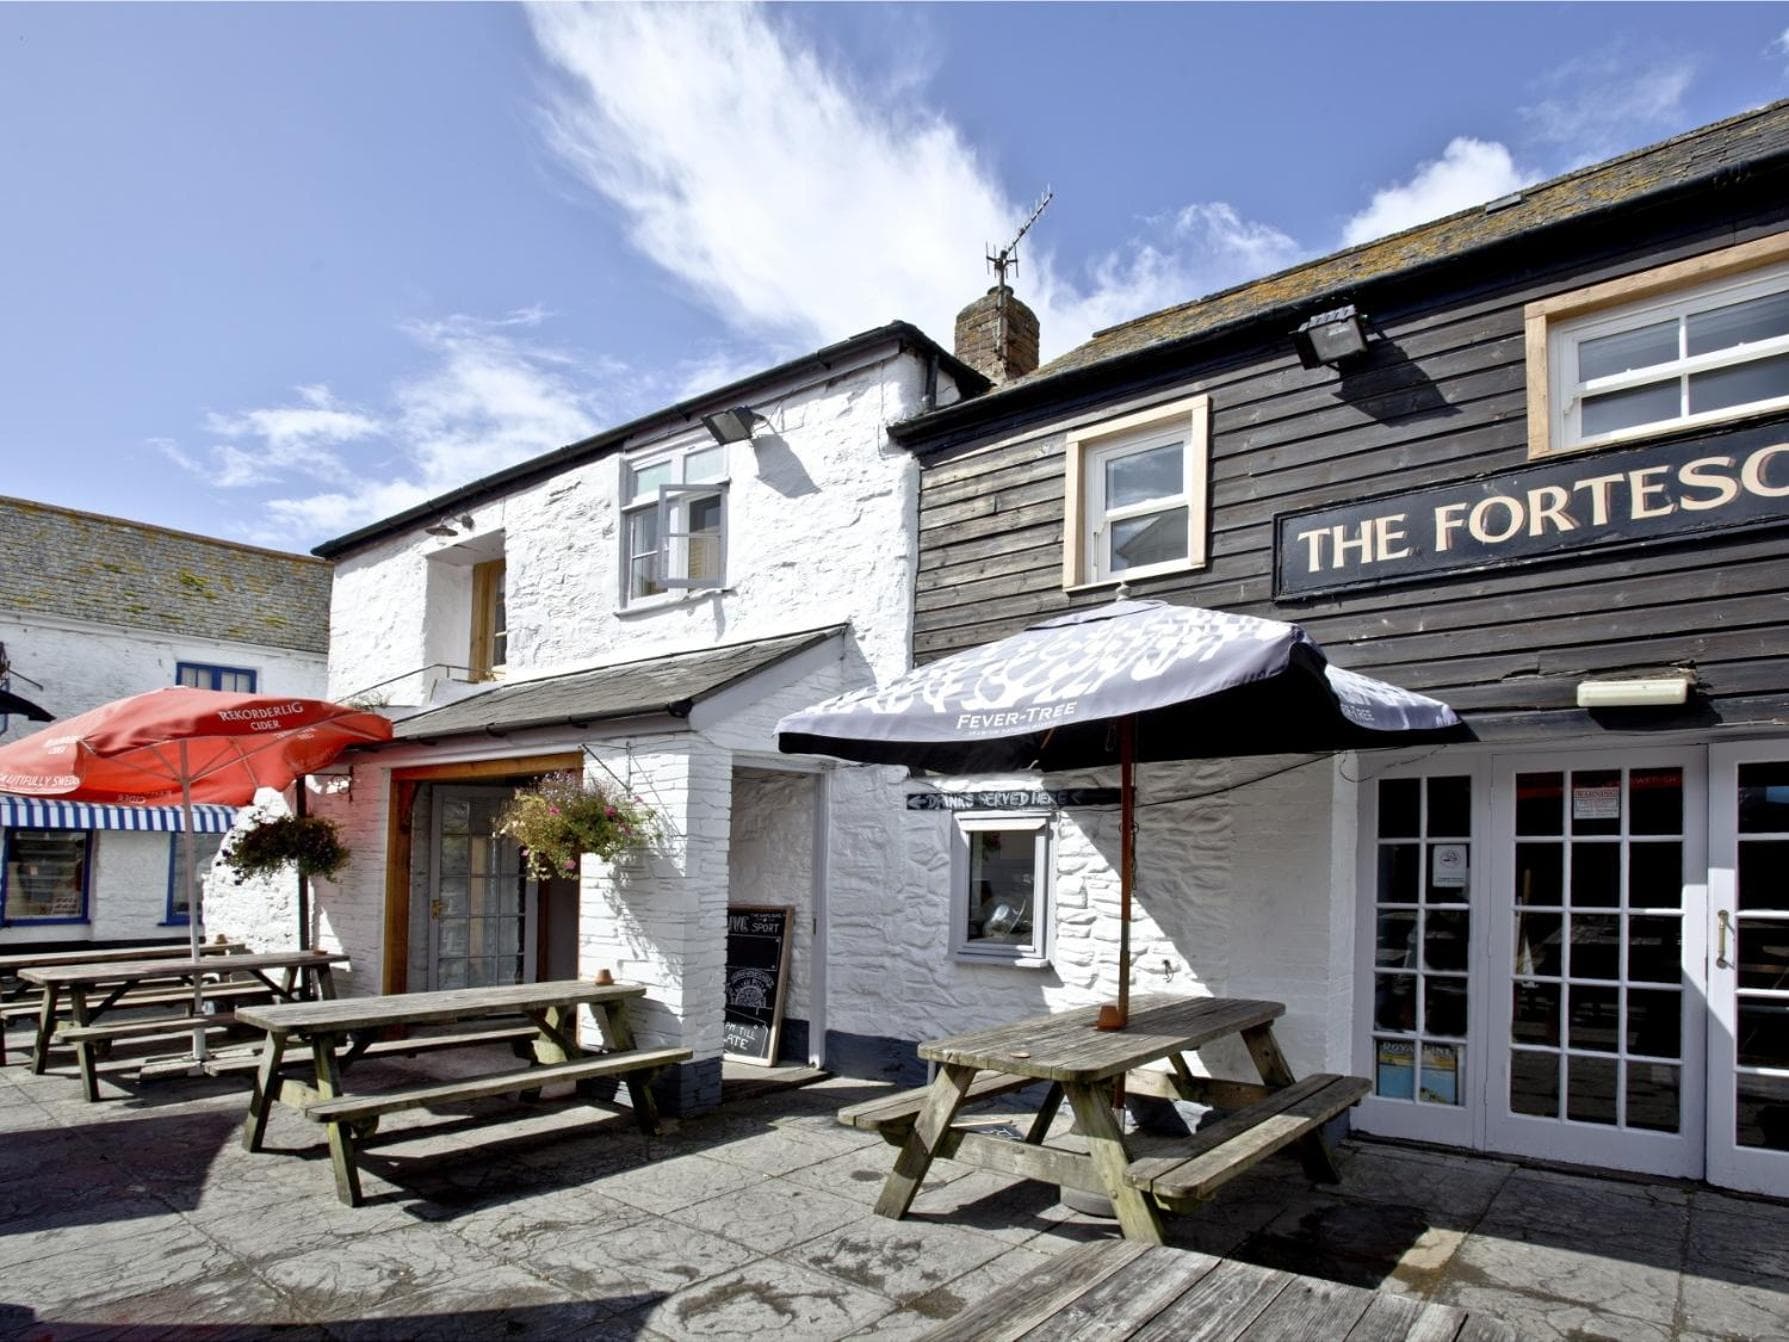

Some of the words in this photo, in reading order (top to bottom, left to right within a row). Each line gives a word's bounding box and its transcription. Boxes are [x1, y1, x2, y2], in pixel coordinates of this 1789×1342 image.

[1297, 513, 1411, 574] THE
[1434, 442, 1789, 552] FORTESC
[218, 702, 304, 721] REKORDERLIG
[956, 702, 1078, 730] FEVER-TREE
[250, 719, 281, 731] CIDER
